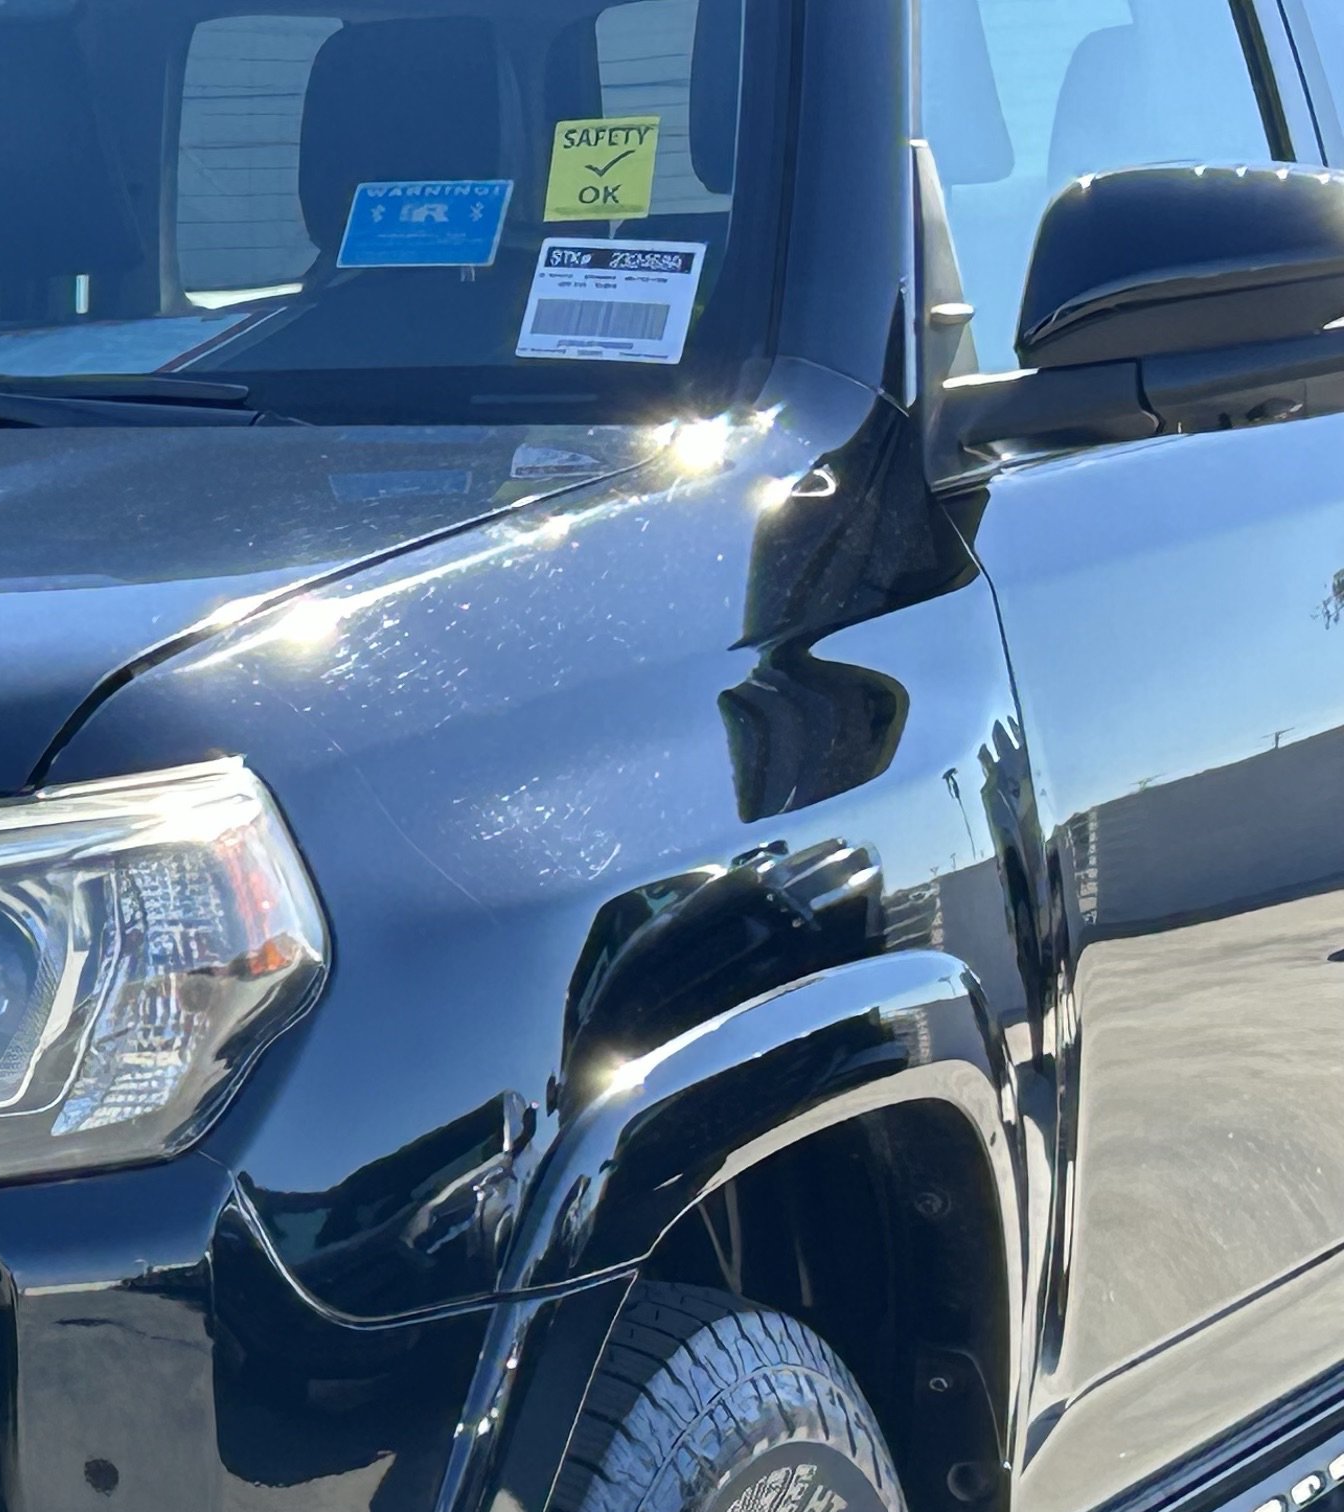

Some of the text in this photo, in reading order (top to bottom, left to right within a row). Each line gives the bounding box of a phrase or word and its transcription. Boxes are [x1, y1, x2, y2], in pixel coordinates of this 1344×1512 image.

[564, 126, 653, 149] SAFETY
[367, 184, 500, 198] WARNING!
[578, 184, 622, 204] OK
